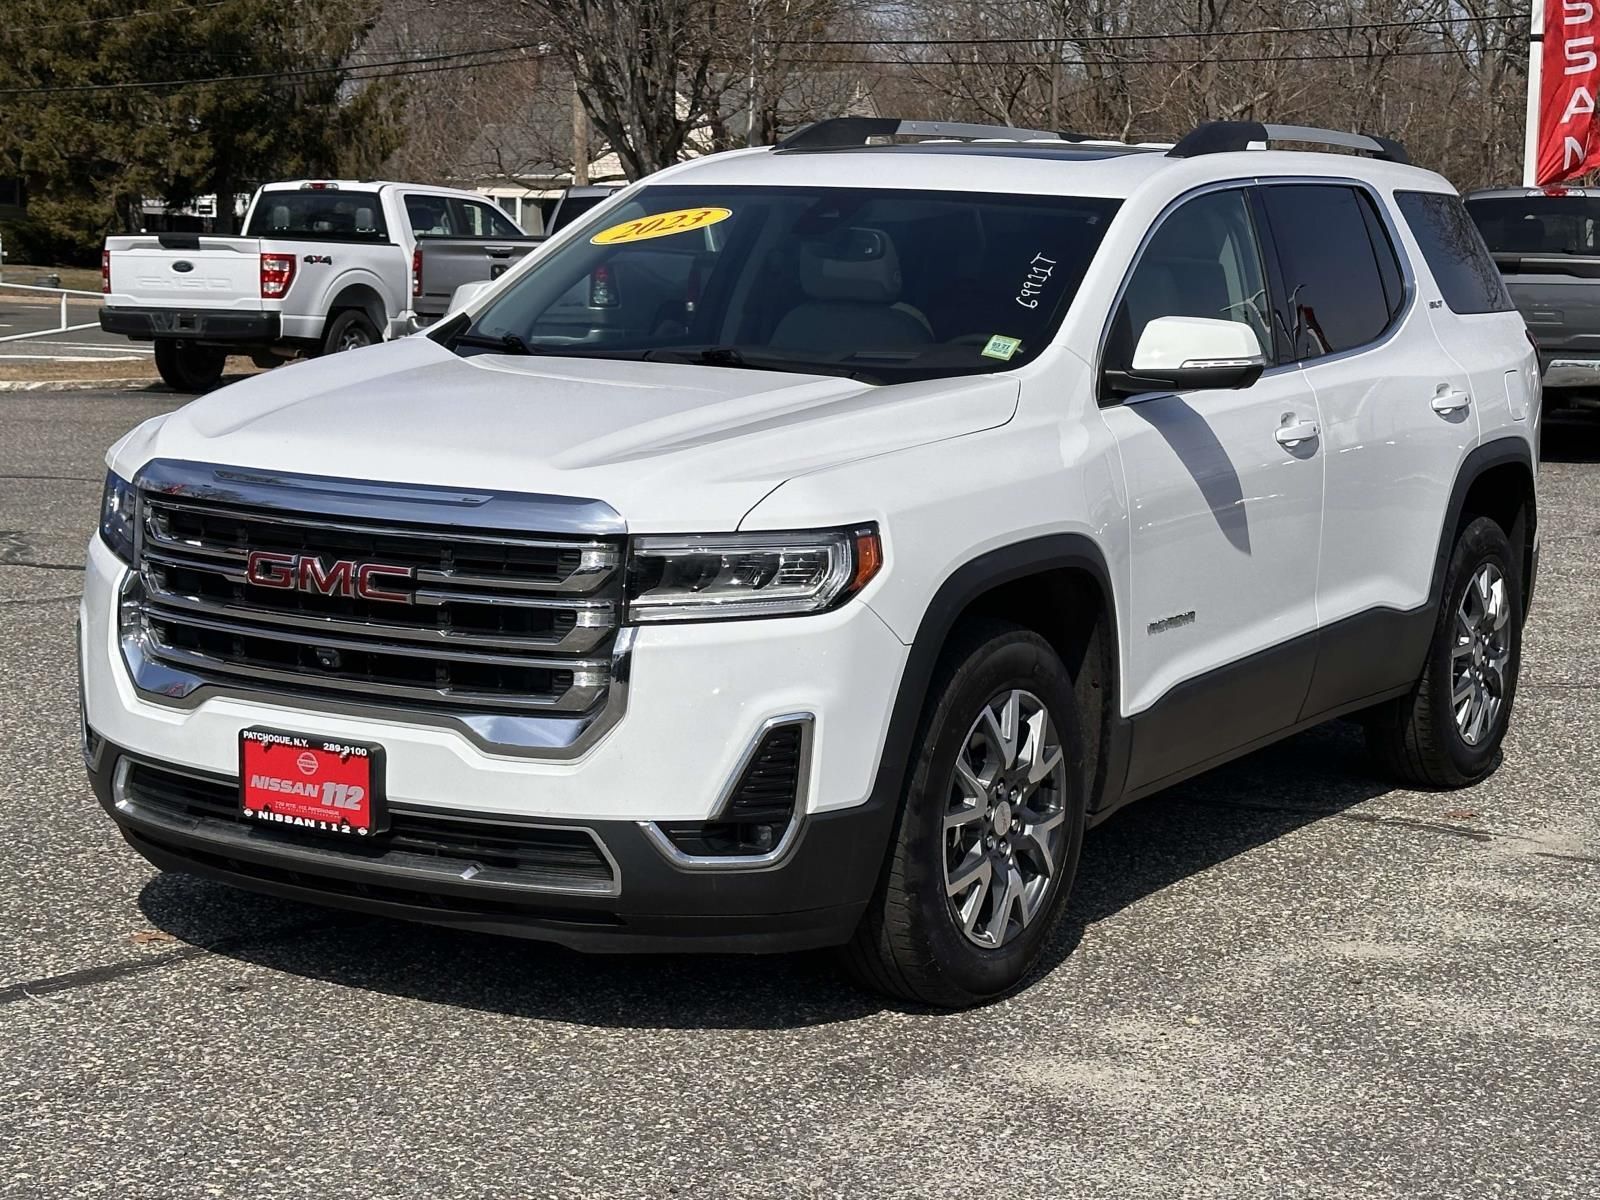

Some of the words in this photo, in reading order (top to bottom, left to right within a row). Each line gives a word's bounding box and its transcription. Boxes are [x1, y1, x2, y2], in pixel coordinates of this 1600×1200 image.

[610, 211, 712, 241] 2023
[248, 551, 413, 605] GMC
[243, 730, 293, 746] PATCHOGUE,
[294, 738, 309, 748] N.Y.
[323, 742, 368, 756] 289-9100
[251, 774, 320, 798] NISSAN
[321, 781, 365, 811] 112
[258, 810, 315, 828] NISSAN
[320, 821, 351, 834] 112
